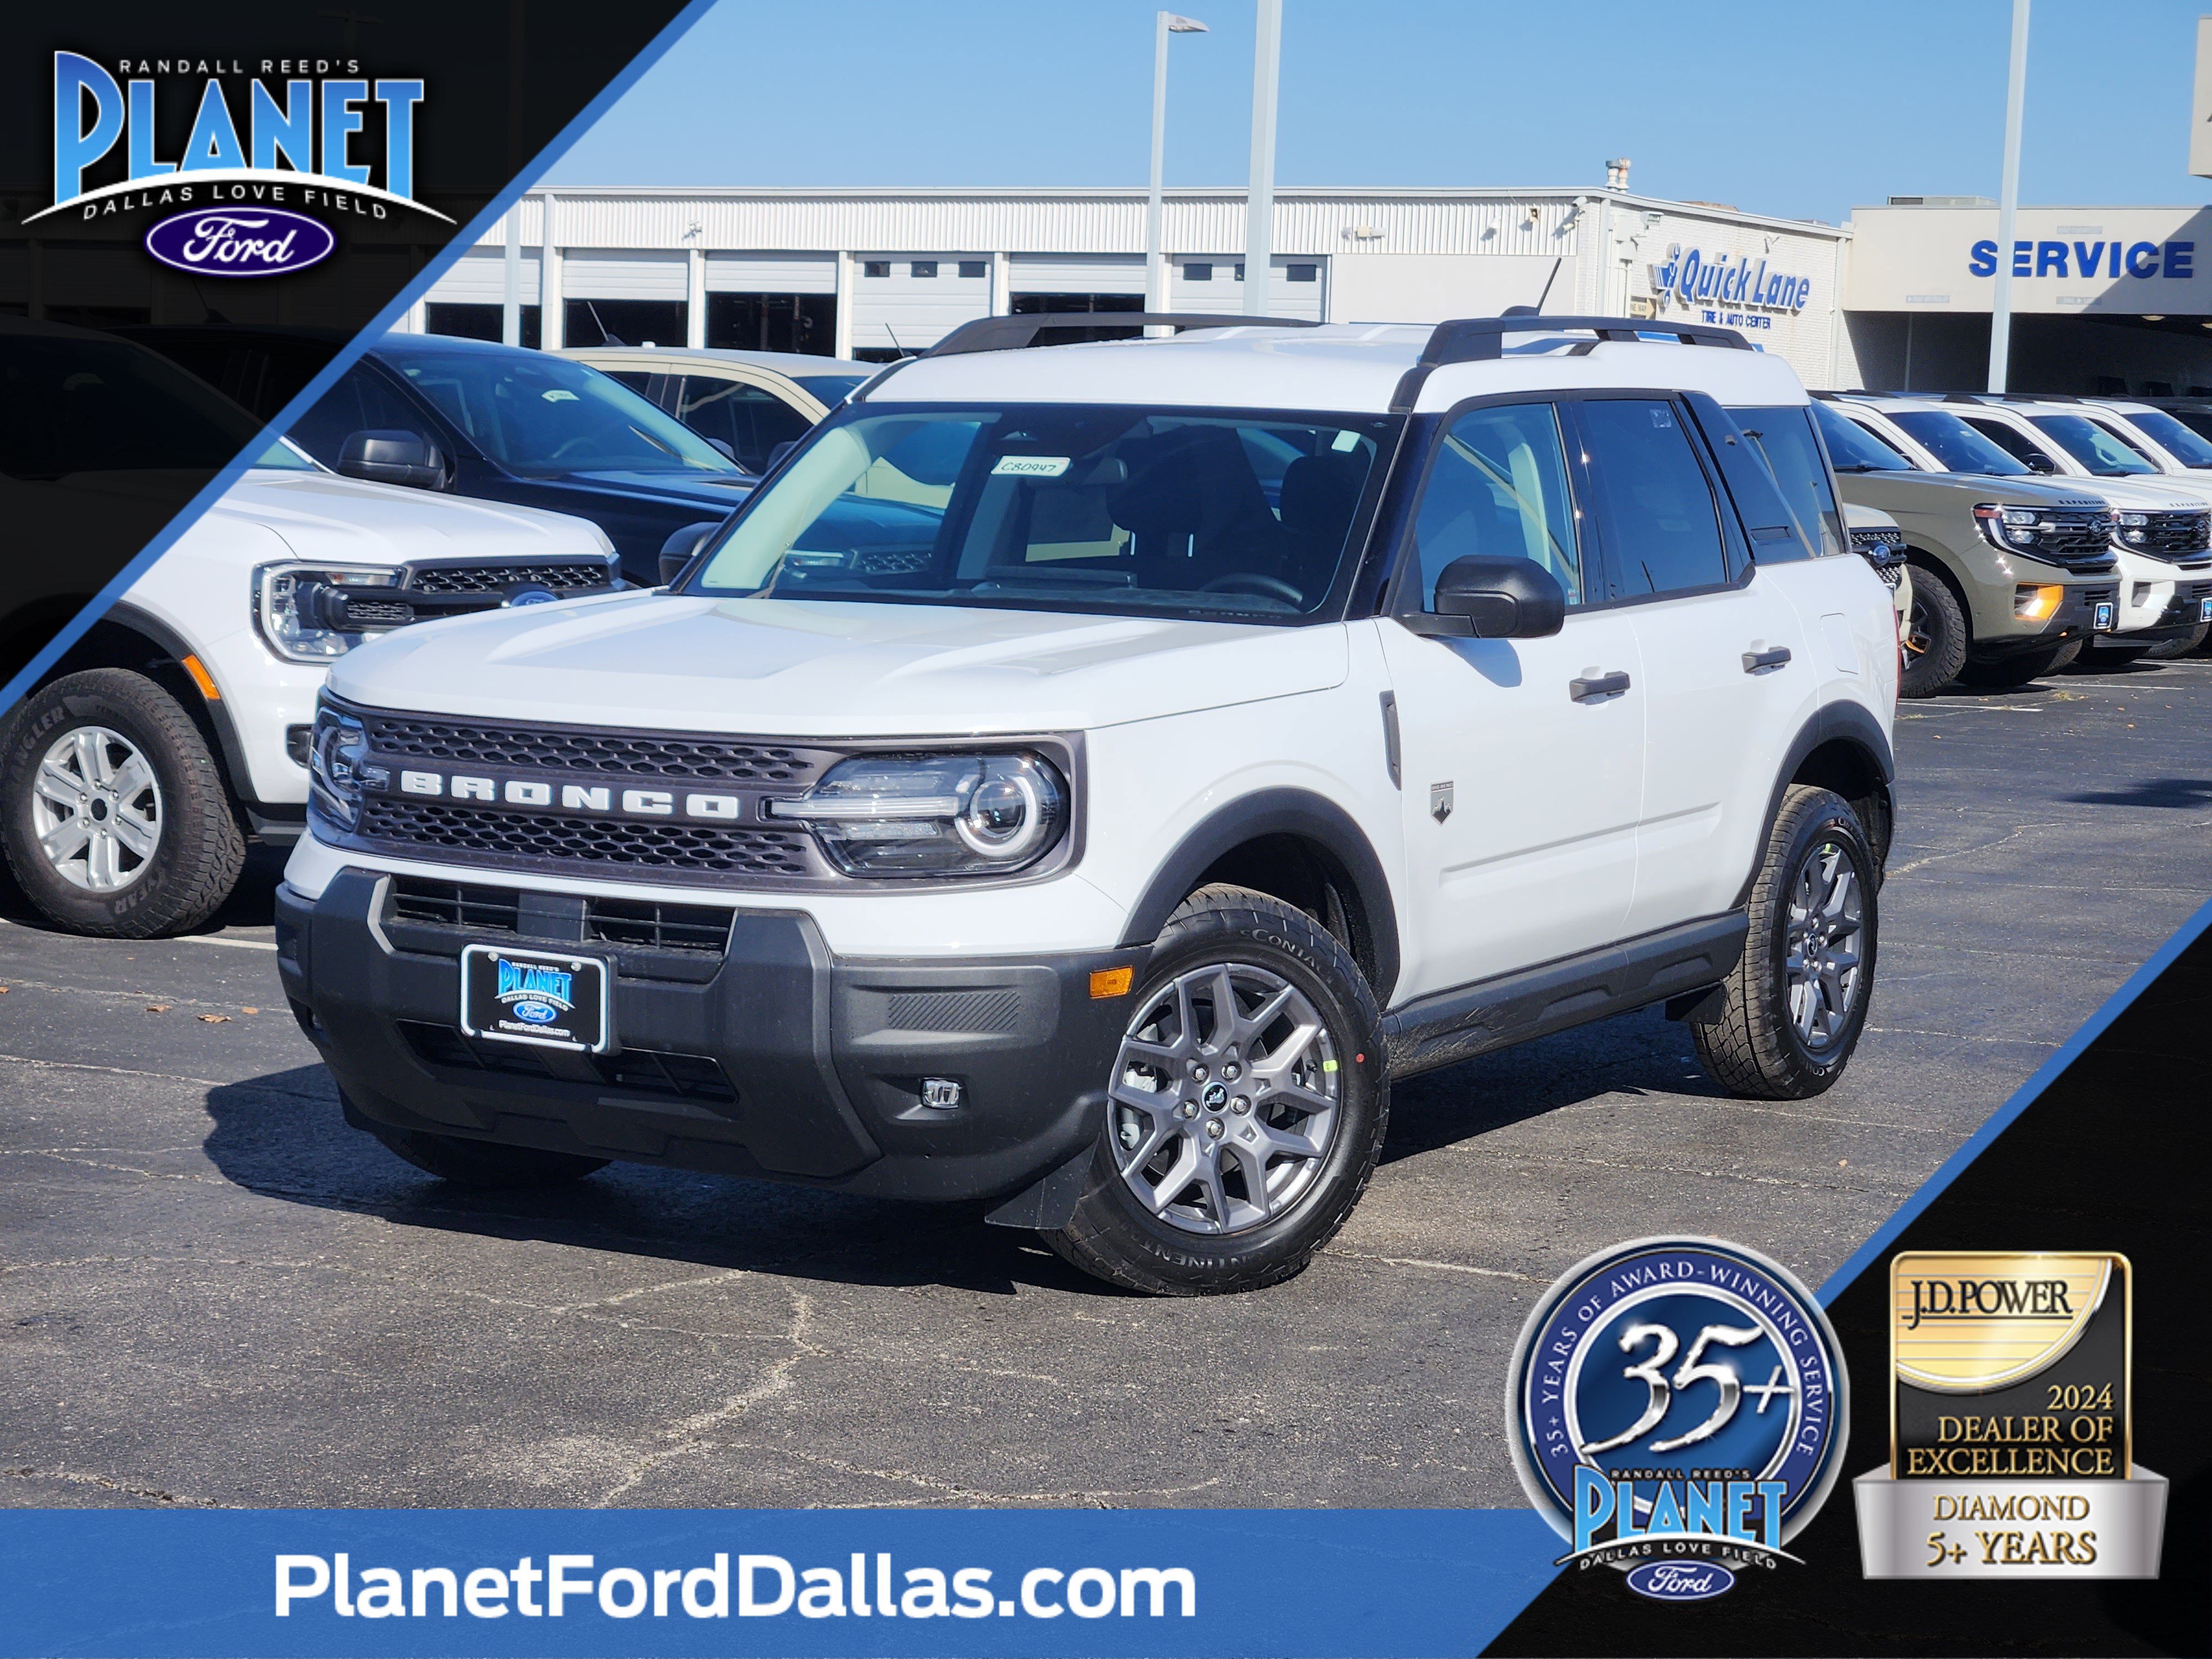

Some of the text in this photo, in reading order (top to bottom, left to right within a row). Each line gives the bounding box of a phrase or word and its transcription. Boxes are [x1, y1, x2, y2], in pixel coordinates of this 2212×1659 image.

[1679, 247, 1811, 311] Quick Lane
[1968, 239, 2195, 279] SERVICE
[400, 770, 739, 819] BRONCO
[499, 958, 572, 1003] PLANET
[501, 994, 526, 1004] DALLAS
[521, 1005, 546, 1020] Ford
